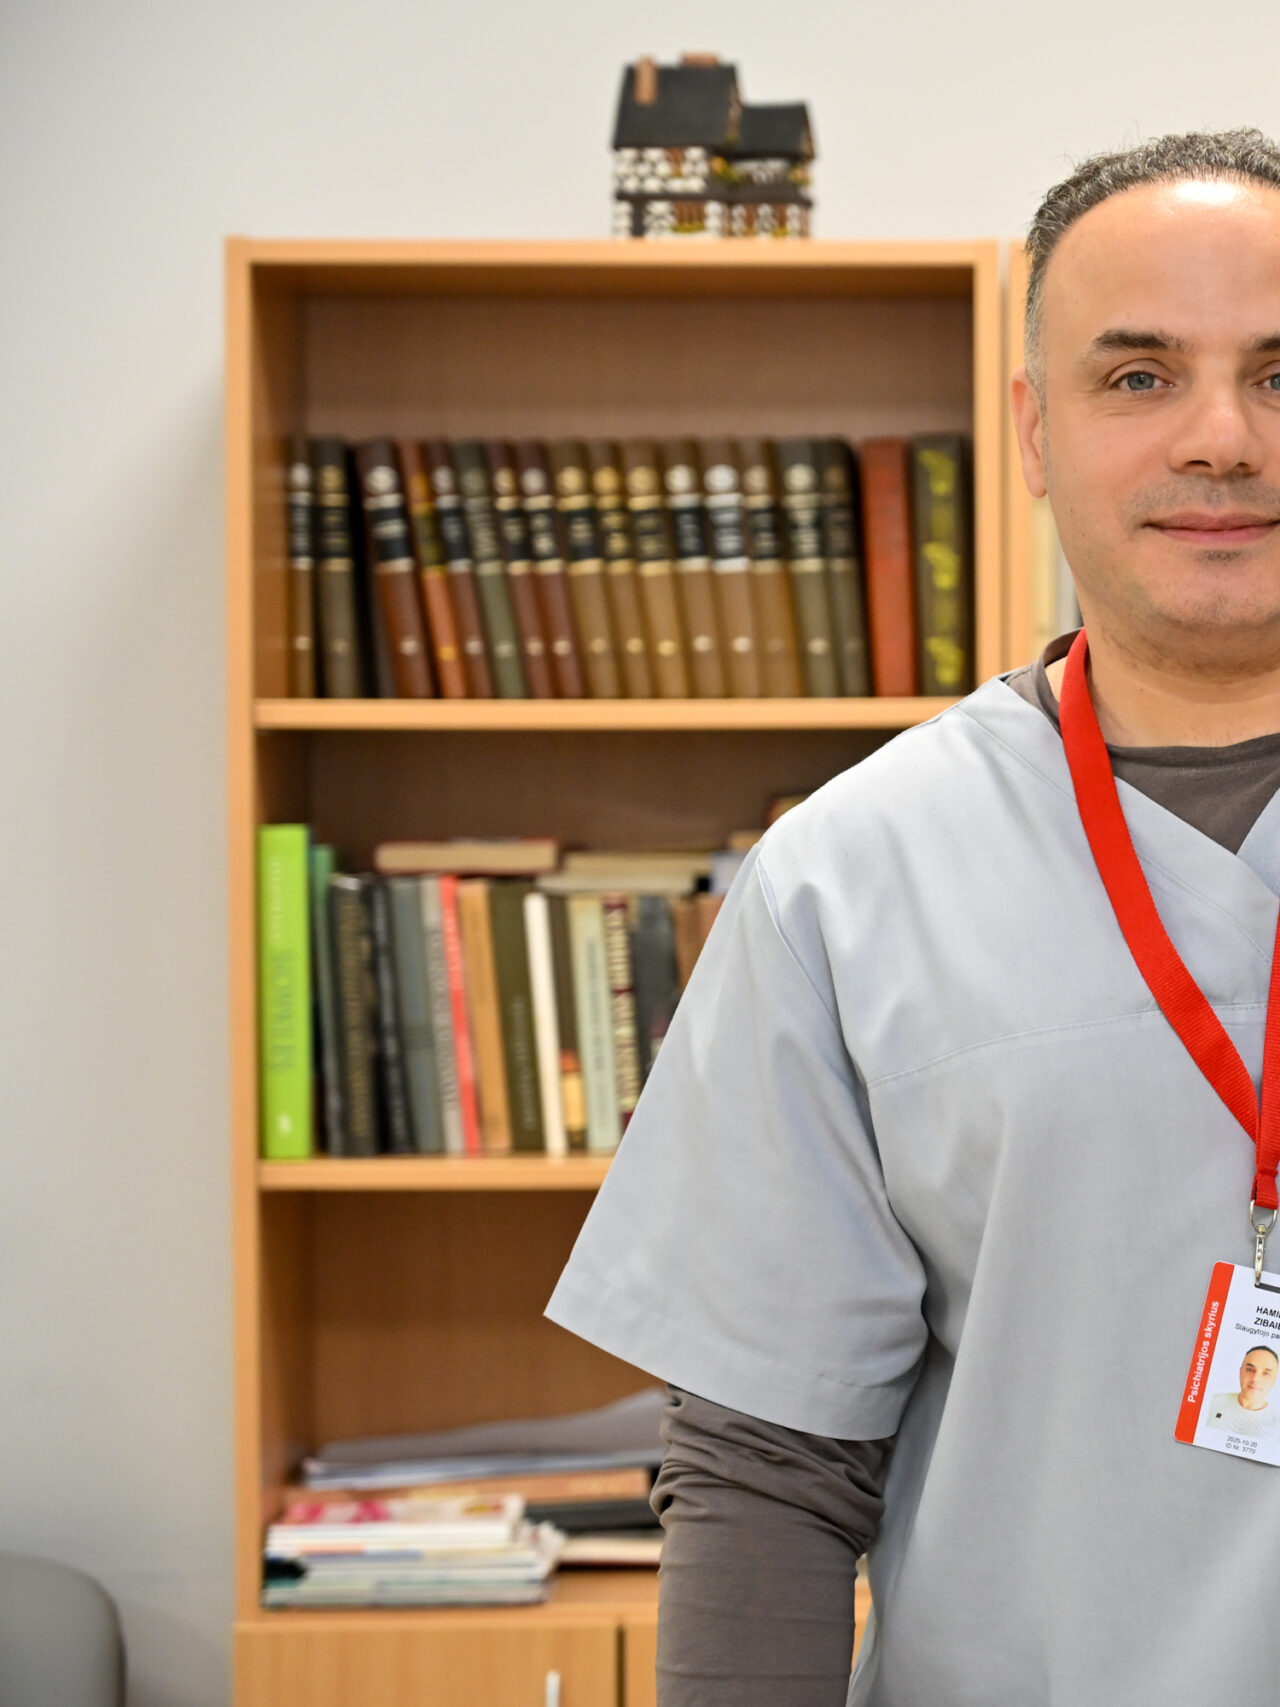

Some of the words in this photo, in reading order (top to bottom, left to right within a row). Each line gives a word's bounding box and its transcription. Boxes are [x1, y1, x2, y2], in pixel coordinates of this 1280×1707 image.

[1187, 1339, 1209, 1403] Psichiatrijos
[1204, 1301, 1219, 1338] skyrius
[1235, 1323, 1270, 1337] Slaugytojo
